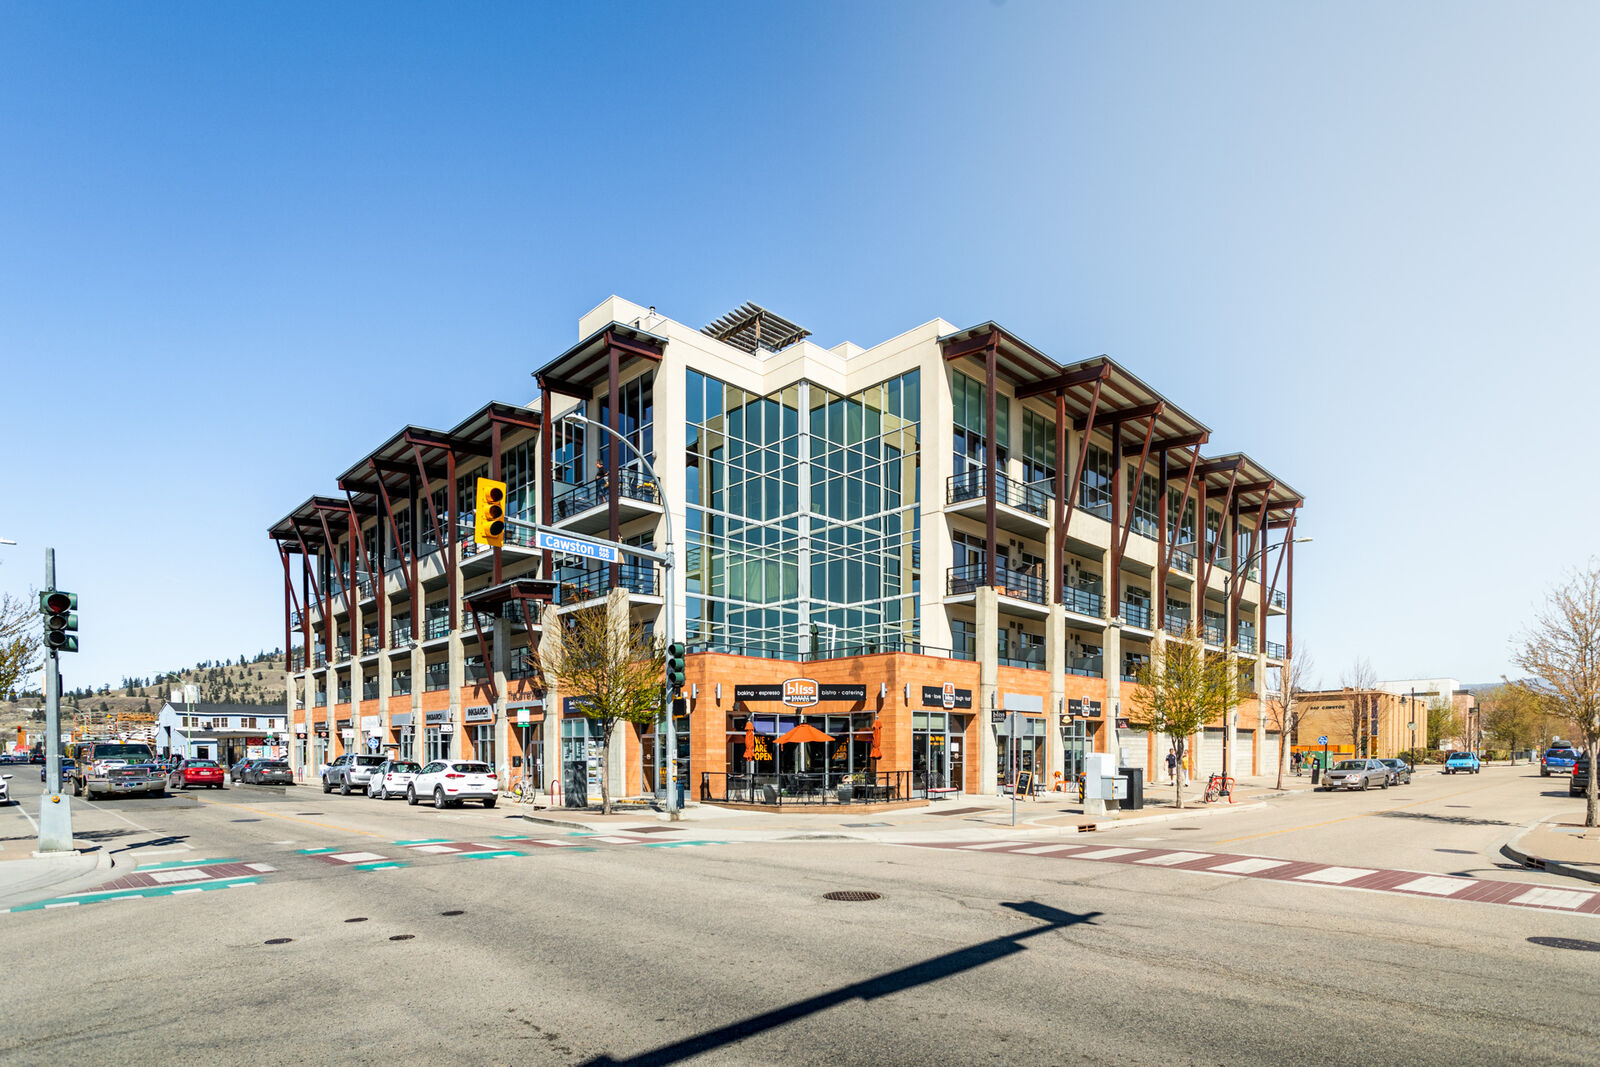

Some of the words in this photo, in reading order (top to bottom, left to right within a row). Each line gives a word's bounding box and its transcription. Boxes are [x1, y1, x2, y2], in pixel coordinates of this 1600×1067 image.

[545, 536, 594, 556] Cawston
[787, 682, 814, 695] bliss
[754, 736, 765, 744] WE
[754, 744, 767, 753] ARE
[754, 752, 772, 761] OPEN
